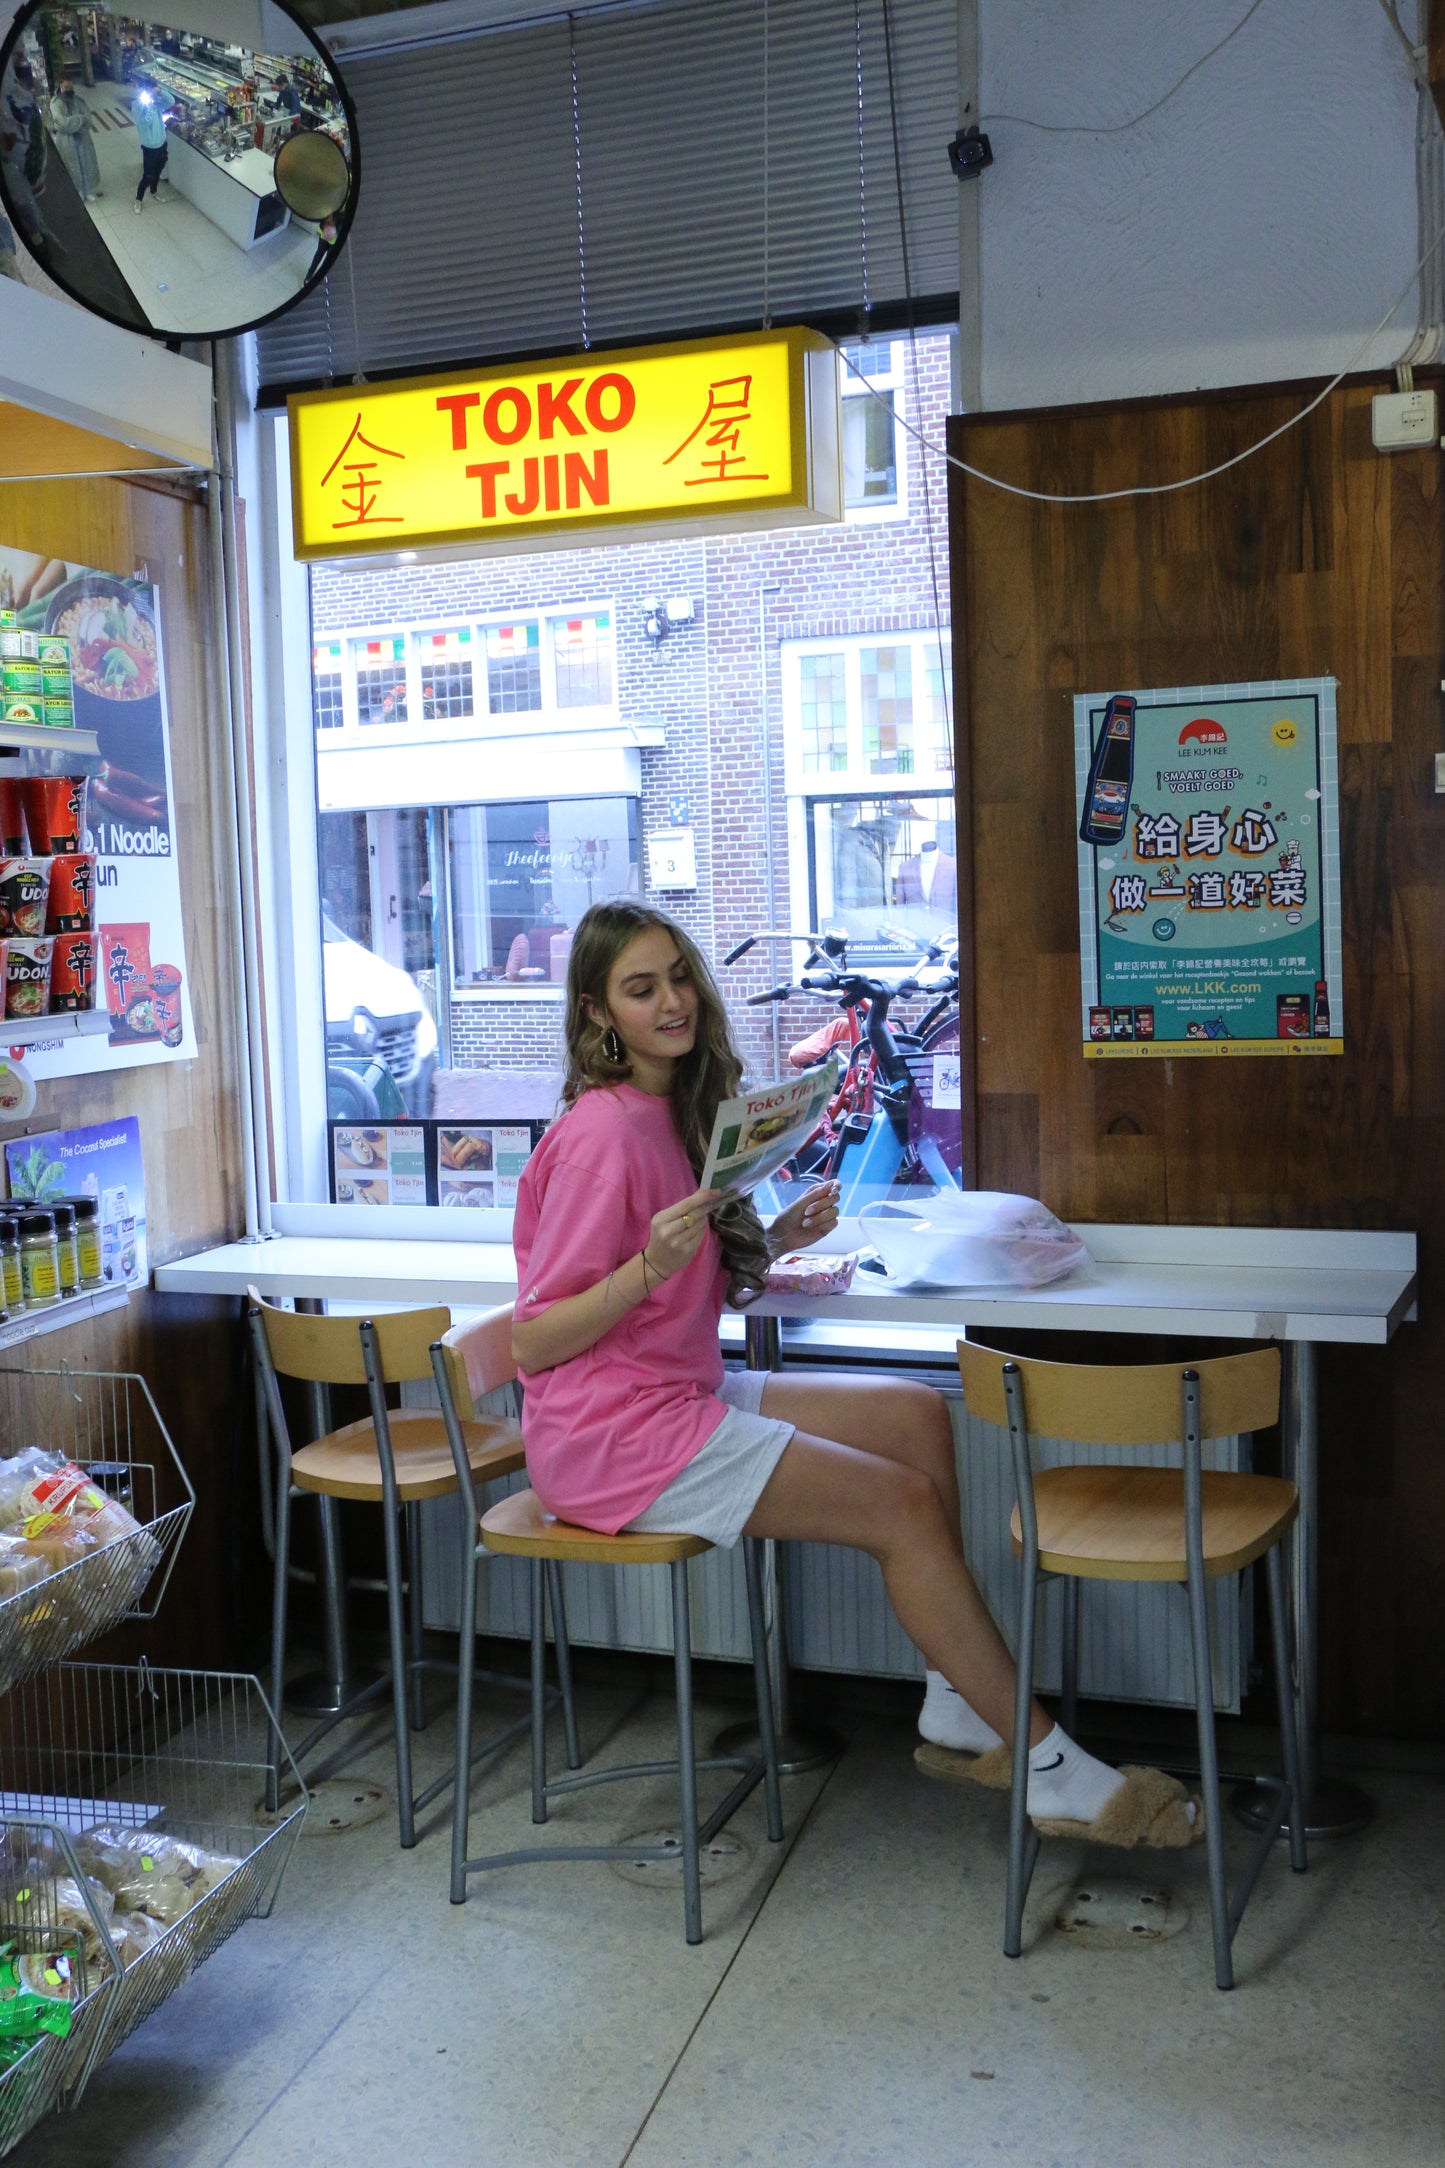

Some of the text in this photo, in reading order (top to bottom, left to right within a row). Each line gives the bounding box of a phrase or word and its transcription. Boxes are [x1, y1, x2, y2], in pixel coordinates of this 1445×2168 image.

[436, 373, 636, 451] TOKO
[663, 374, 770, 486] 屋
[321, 412, 405, 529] 金
[466, 448, 610, 519] TJIN
[1178, 747, 1227, 757] LEE KUM KEE
[1163, 768, 1244, 781] SMAAKT GOED,
[1169, 780, 1235, 793] VOELT GOED
[111, 824, 169, 854] Noodle
[1137, 809, 1278, 857] 給身心
[667, 860, 675, 872] 3
[1111, 869, 1306, 911] 做一道好菜
[67, 941, 94, 987] 辛
[7, 966, 50, 980] UDON
[109, 943, 135, 1006] 辛
[1155, 981, 1262, 995] www.LKK.com
[746, 1094, 784, 1115] Toko
[394, 1129, 422, 1138] Toko Tjin
[500, 1129, 529, 1138] Toko Tjin
[60, 1145, 73, 1158] The
[395, 1179, 411, 1187] Toko
[501, 1179, 517, 1187] Toko
